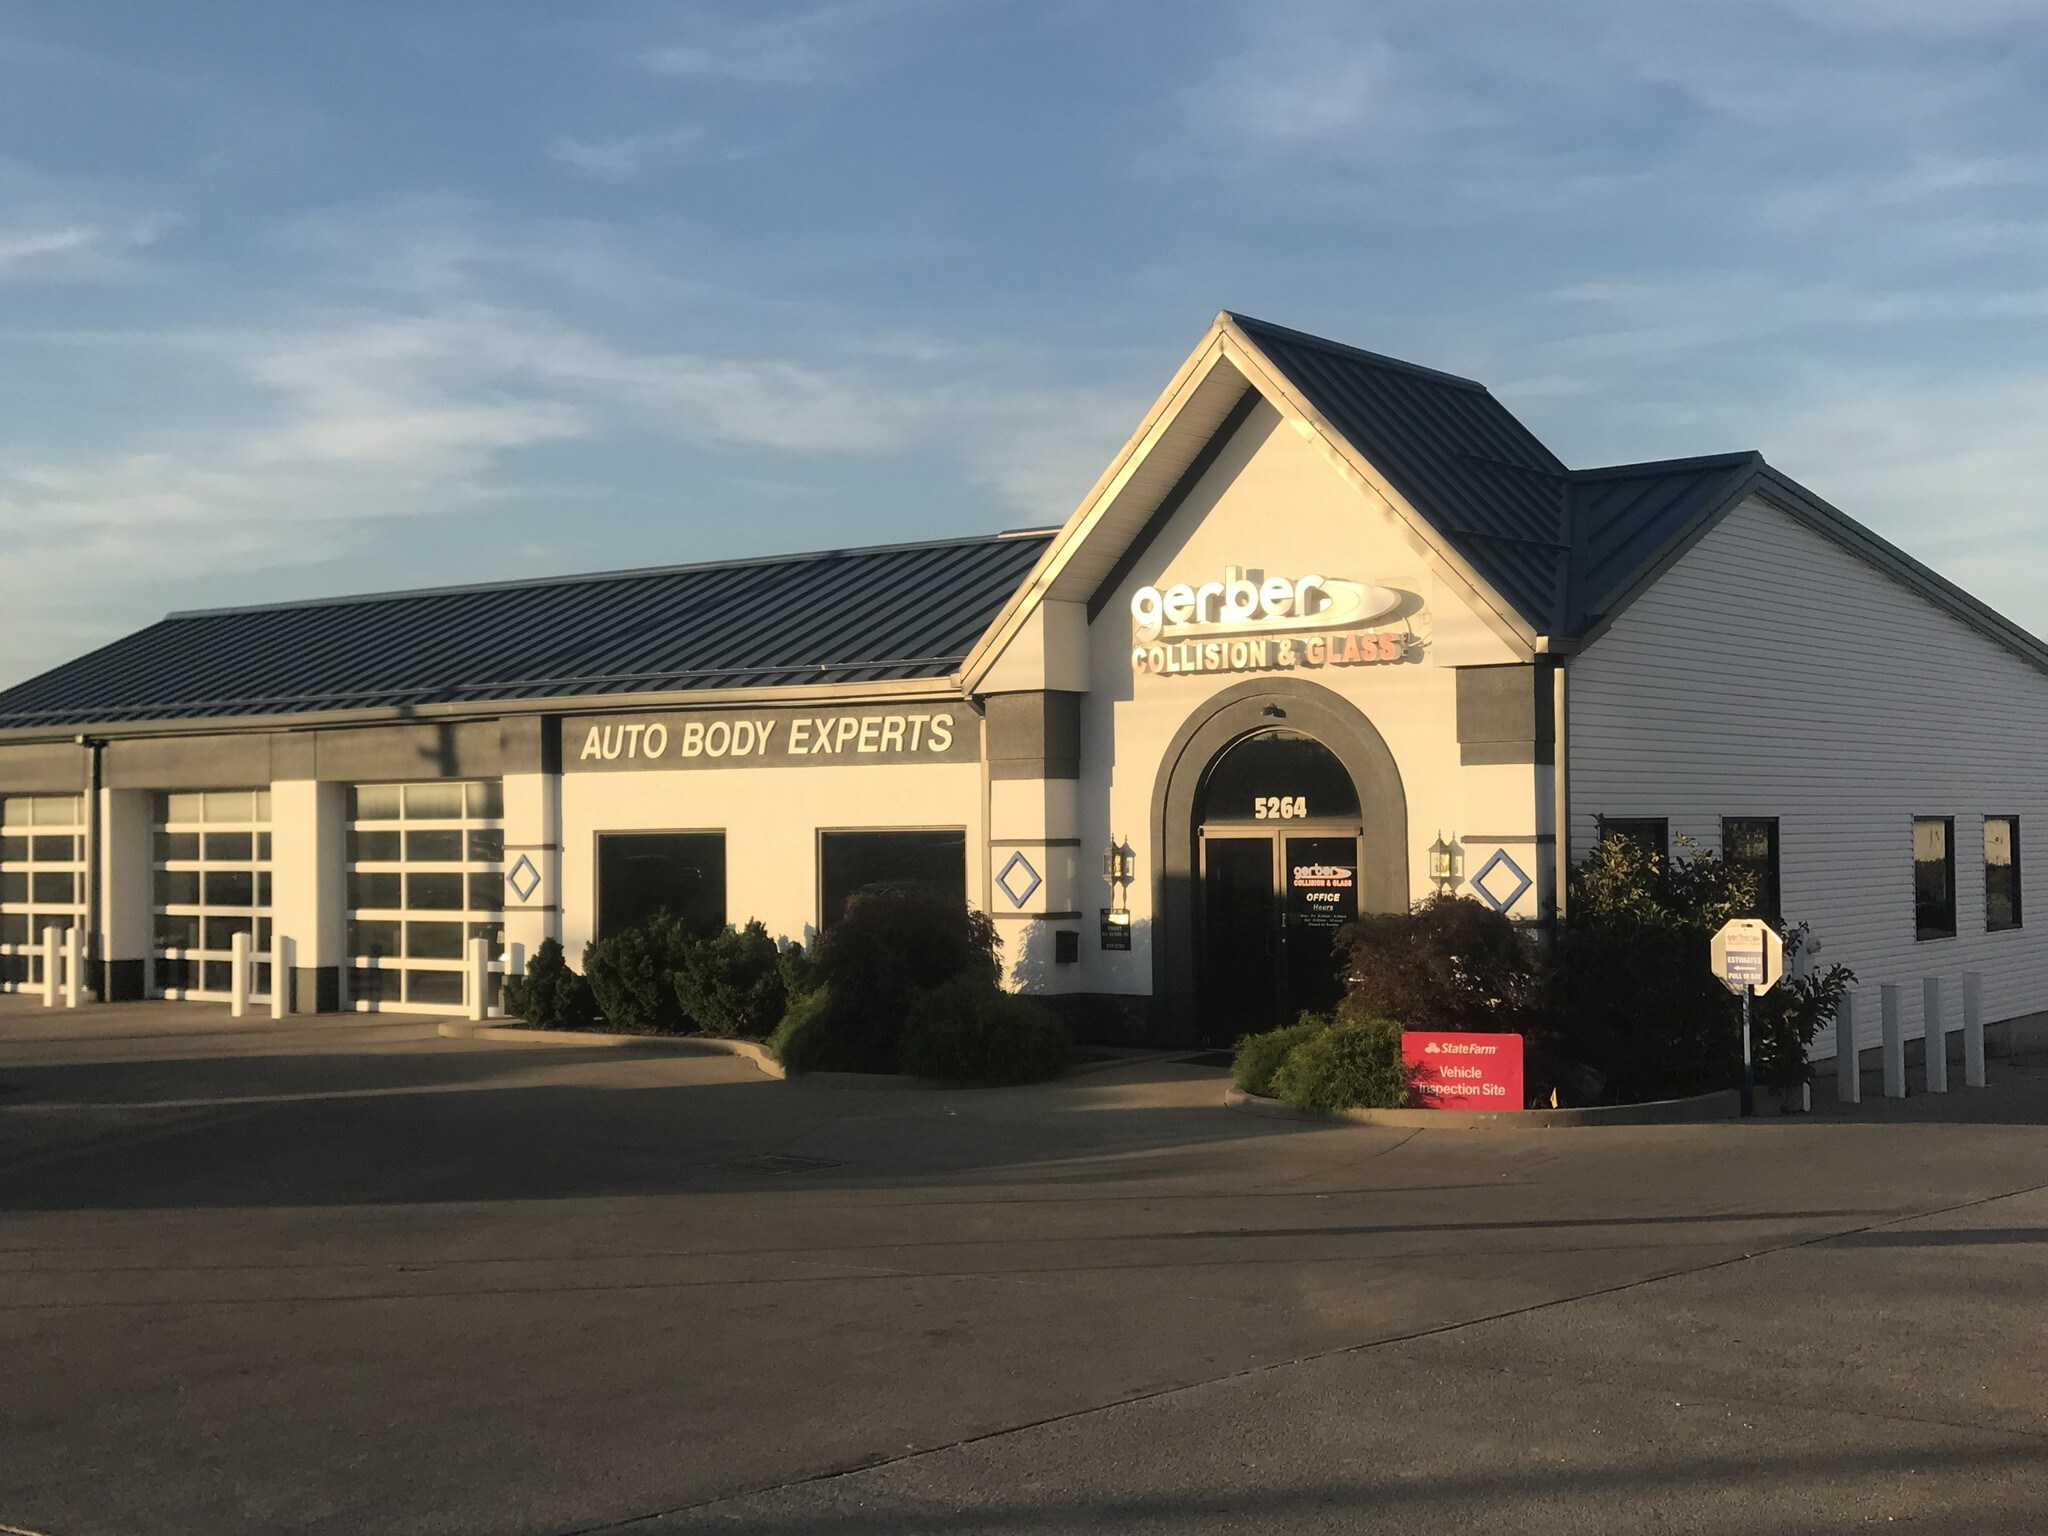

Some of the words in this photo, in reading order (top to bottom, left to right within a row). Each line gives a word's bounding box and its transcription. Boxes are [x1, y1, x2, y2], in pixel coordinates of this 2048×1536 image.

[1131, 565, 1327, 641] gerber
[1132, 640, 1268, 674] COLLISION
[1278, 638, 1297, 667] &
[1306, 632, 1396, 664] GLASS
[580, 723, 669, 760] AUTO
[681, 719, 776, 757] BODY
[787, 713, 955, 754] EXPERTS
[1254, 796, 1307, 819] 5264
[1293, 863, 1338, 879] gerber
[1293, 879, 1325, 887] COLLISION
[1306, 893, 1341, 902] OFFICE
[1439, 1066, 1482, 1079] Vehicle
[1419, 1083, 1480, 1096] Inspection
[1482, 1083, 1505, 1096] Site
